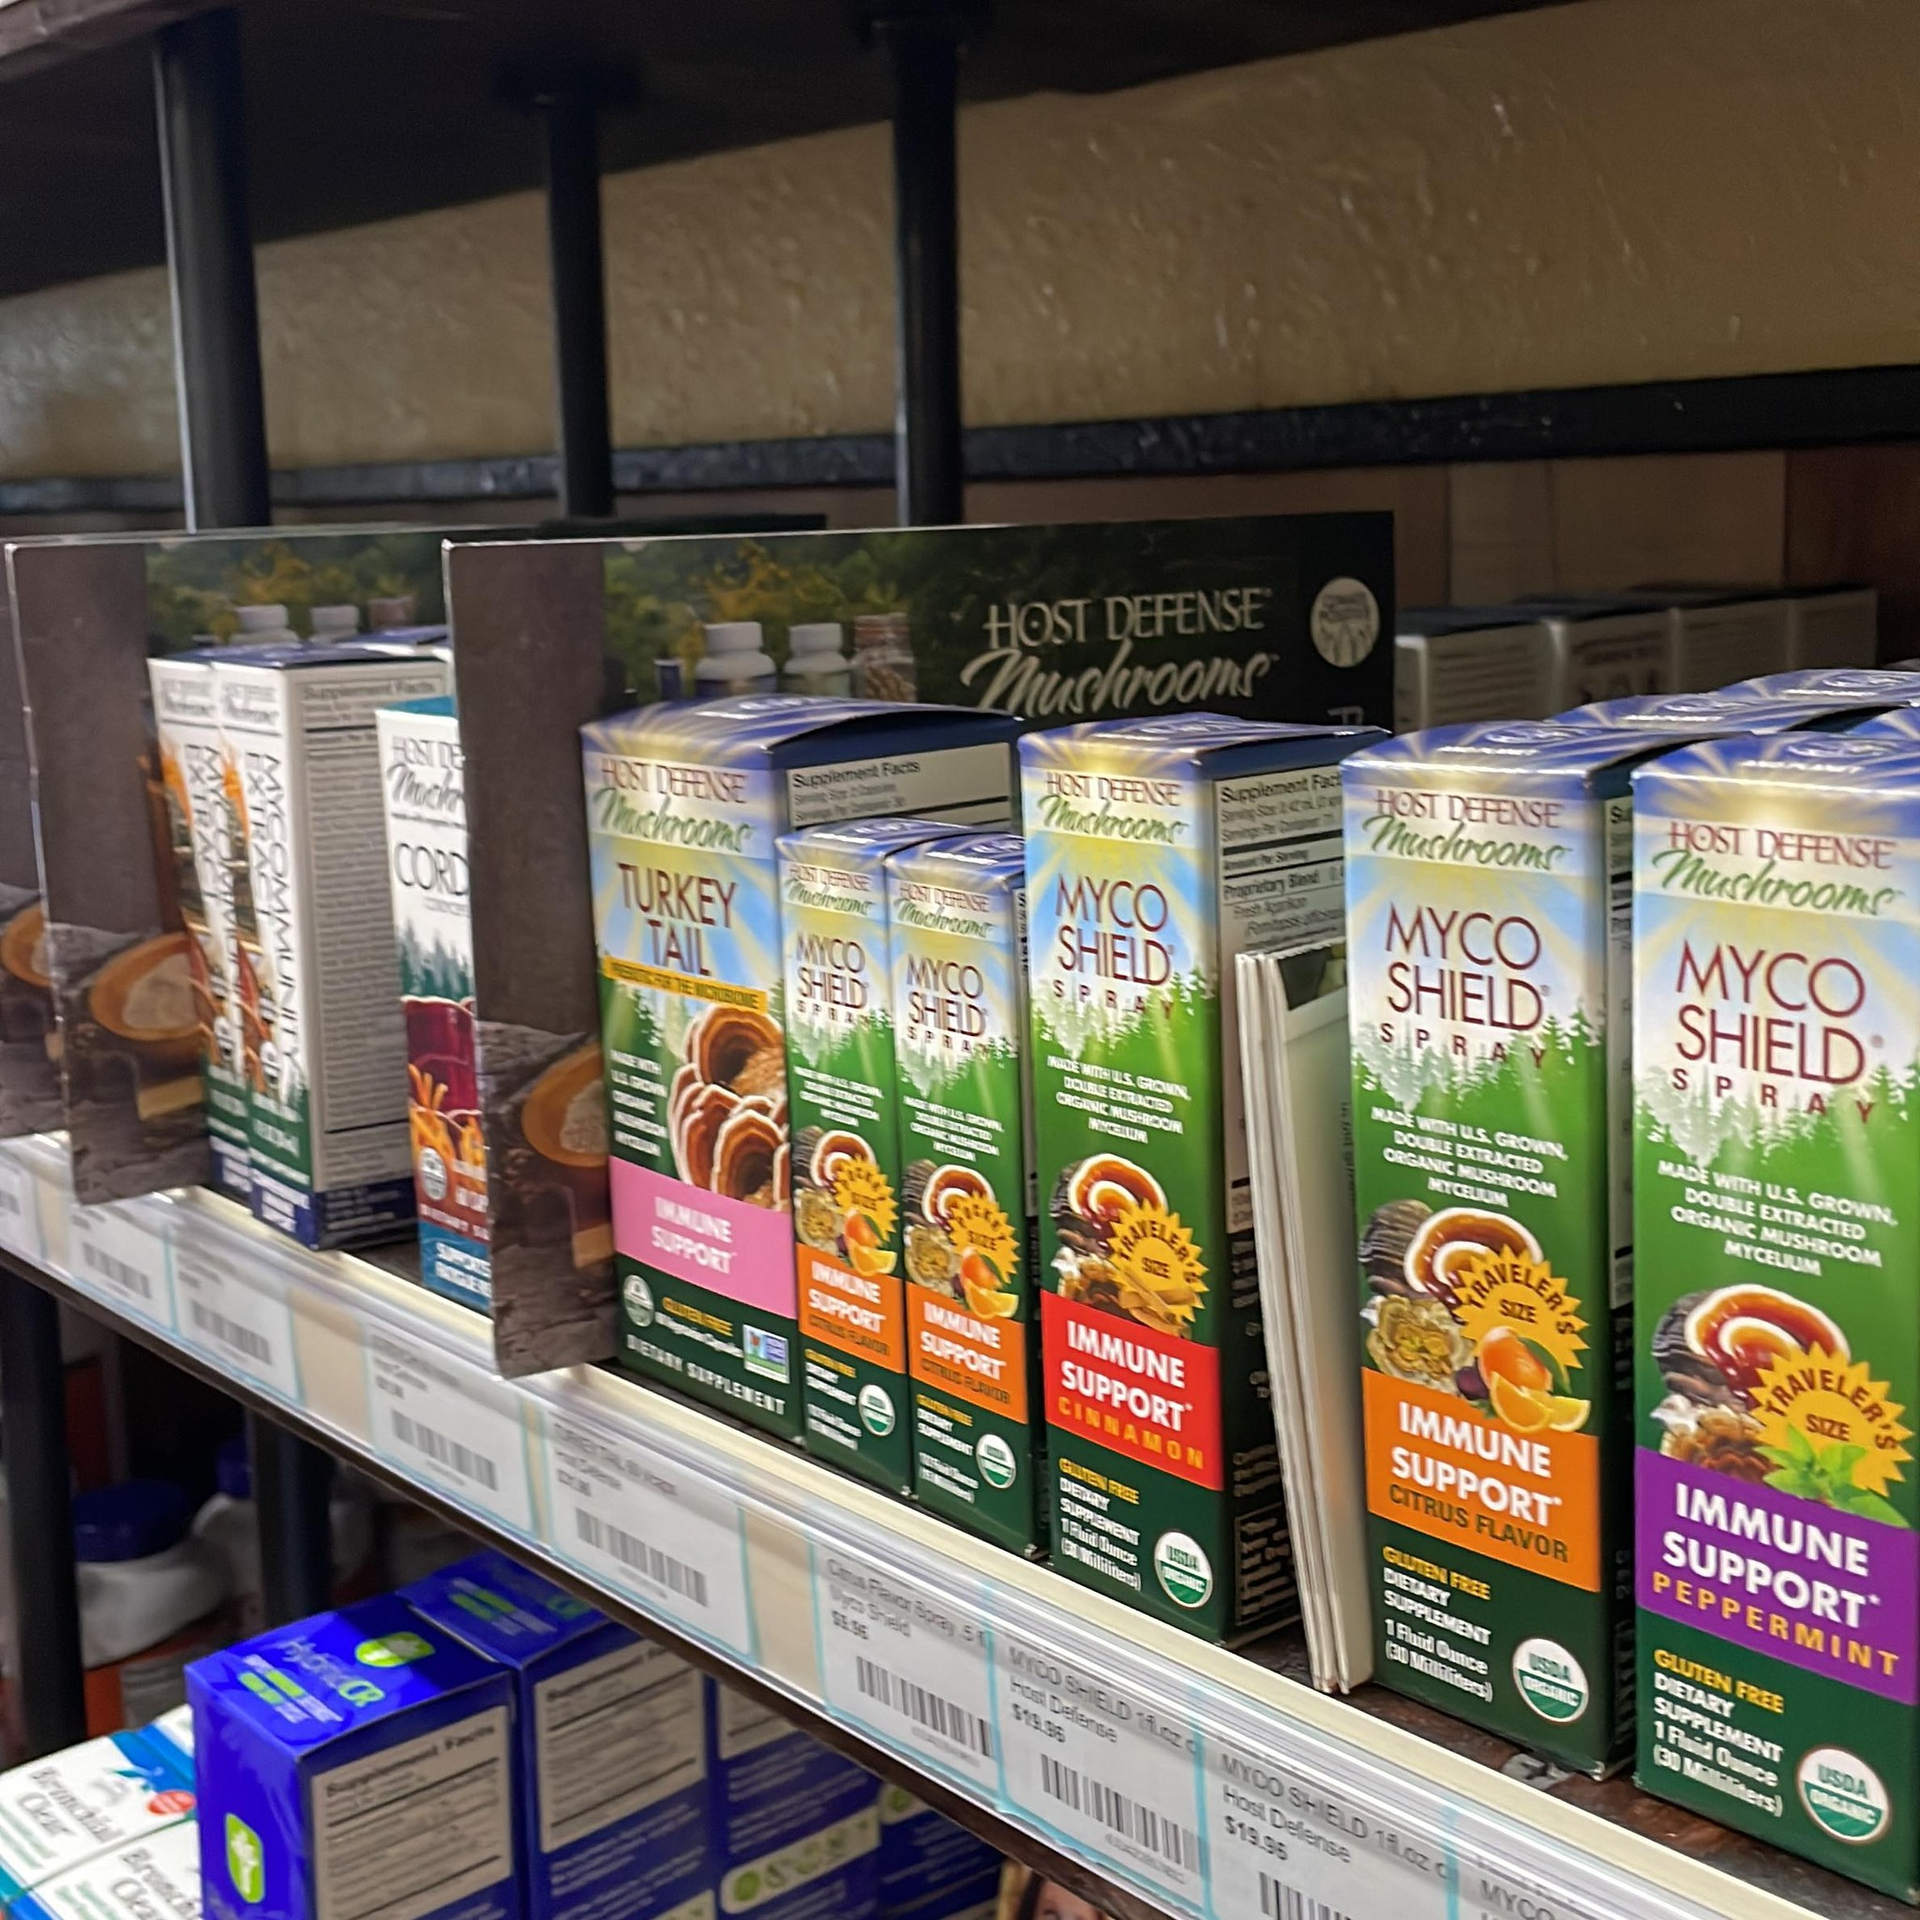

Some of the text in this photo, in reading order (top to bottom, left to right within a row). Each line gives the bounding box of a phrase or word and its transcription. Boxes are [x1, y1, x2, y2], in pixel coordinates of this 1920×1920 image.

[982, 588, 1264, 650] HOST DEFENSE
[960, 640, 1270, 718] Mushrooms
[602, 760, 747, 803] HOST DEFENSE
[792, 760, 921, 789] Supplement Facts
[1047, 772, 1182, 806] HOST DEFENSE
[593, 787, 752, 852] Mushrooms
[1038, 794, 1183, 843] Mushrooms
[1376, 789, 1564, 829] HOST DEFENSE
[1362, 814, 1567, 871] Mushrooms
[1669, 821, 1897, 869] HOST DEFENSE
[618, 863, 738, 928] TURKEY
[1056, 874, 1167, 932] MYCO
[1652, 849, 1896, 916] Mushrooms
[648, 919, 711, 976] TAIL
[796, 931, 866, 973] MYCO
[1058, 925, 1170, 986] SHIELD
[1385, 901, 1541, 971] MYCO
[797, 967, 867, 1009] SHIELD
[906, 953, 984, 999] MYCO
[1054, 980, 1174, 1020] SPRAY
[1387, 962, 1543, 1031] SHIELD
[1676, 939, 1866, 1018] MYCO
[908, 991, 986, 1037] SHIELD
[1380, 1022, 1546, 1069] SPRAY
[1675, 1004, 1866, 1085] SHIELD
[1671, 1068, 1875, 1124] SPRAY
[1371, 1107, 1569, 1161] MADE WITH U.S. GROWN,
[1393, 1130, 1543, 1174] DOUBLE EXTRACTED
[1383, 1148, 1557, 1198] ORGANIC MUSHROOM
[1428, 1176, 1509, 1208] MYCELIUM
[1658, 1160, 1898, 1227] MADE WITH U.S. GROWN,
[655, 1196, 732, 1243] IMMUNE
[1670, 1206, 1882, 1267] ORGANIC MUSHROOM
[1685, 1187, 1866, 1240] DOUBLE EXTRACTED
[652, 1225, 731, 1274] SUPPORT
[1141, 1256, 1171, 1279] SIZE
[1724, 1240, 1822, 1276] MYCELIUM
[811, 1261, 881, 1303] IMMUNE
[1467, 1263, 1577, 1336] TRAVELER'S
[809, 1289, 881, 1333] SUPPORT
[923, 1301, 1001, 1349] IMMUNE
[1500, 1299, 1538, 1324] SIZE
[921, 1331, 1001, 1380] SUPPORT
[1067, 1320, 1185, 1389] IMMUNE
[687, 1362, 786, 1415] SUPPLEMENT
[1061, 1360, 1185, 1432] SUPPORT
[1765, 1368, 1898, 1449] TRAVELER'S
[1058, 1396, 1204, 1469] CINNAMON
[1399, 1401, 1552, 1479] IMMUNE
[1806, 1413, 1850, 1442] SIZE
[1059, 1457, 1140, 1505] GLUTEN FREE
[1060, 1477, 1110, 1511] DIETARY
[1391, 1446, 1551, 1527] SUPPORT
[1060, 1497, 1140, 1546] SUPPLEMENT
[1389, 1483, 1569, 1563] CITRUS FLAVOR
[1676, 1482, 1869, 1577] IMMUNE
[1383, 1546, 1491, 1600] GLUTEN FREE
[1384, 1567, 1450, 1607] DIETARY
[1662, 1530, 1867, 1628] SUPPORT
[868, 1578, 911, 1612] Flavor
[915, 1600, 956, 1637] Spray
[1384, 1589, 1491, 1645] SUPPLEMENT
[1652, 1571, 1899, 1676] PEPPERMINT
[1385, 1618, 1488, 1675] 1 Fluid Ounce
[1528, 1652, 1573, 1683] USDA
[1009, 1646, 1061, 1686] MYCO
[1065, 1675, 1132, 1721] SHIELD
[1410, 1649, 1493, 1703] Milliliters)
[1654, 1649, 1784, 1713] GLUTEN FREE
[1654, 1672, 1735, 1717] DIETARY
[1010, 1674, 1117, 1743] Host Defense
[1654, 1696, 1784, 1762] SUPPLEMENT
[1654, 1720, 1778, 1787] 1 Fluid Ounce
[1222, 1753, 1285, 1798] MYCO
[1289, 1786, 1369, 1839] SHIELD
[1683, 1759, 1783, 1818] Milliliters)
[1810, 1789, 1876, 1825] ORGANIC
[1818, 1764, 1868, 1799] USDA
[1222, 1784, 1352, 1864] Host Defense
[1224, 1815, 1289, 1861] $19.95
[1480, 1879, 1556, 1920] MYCO
